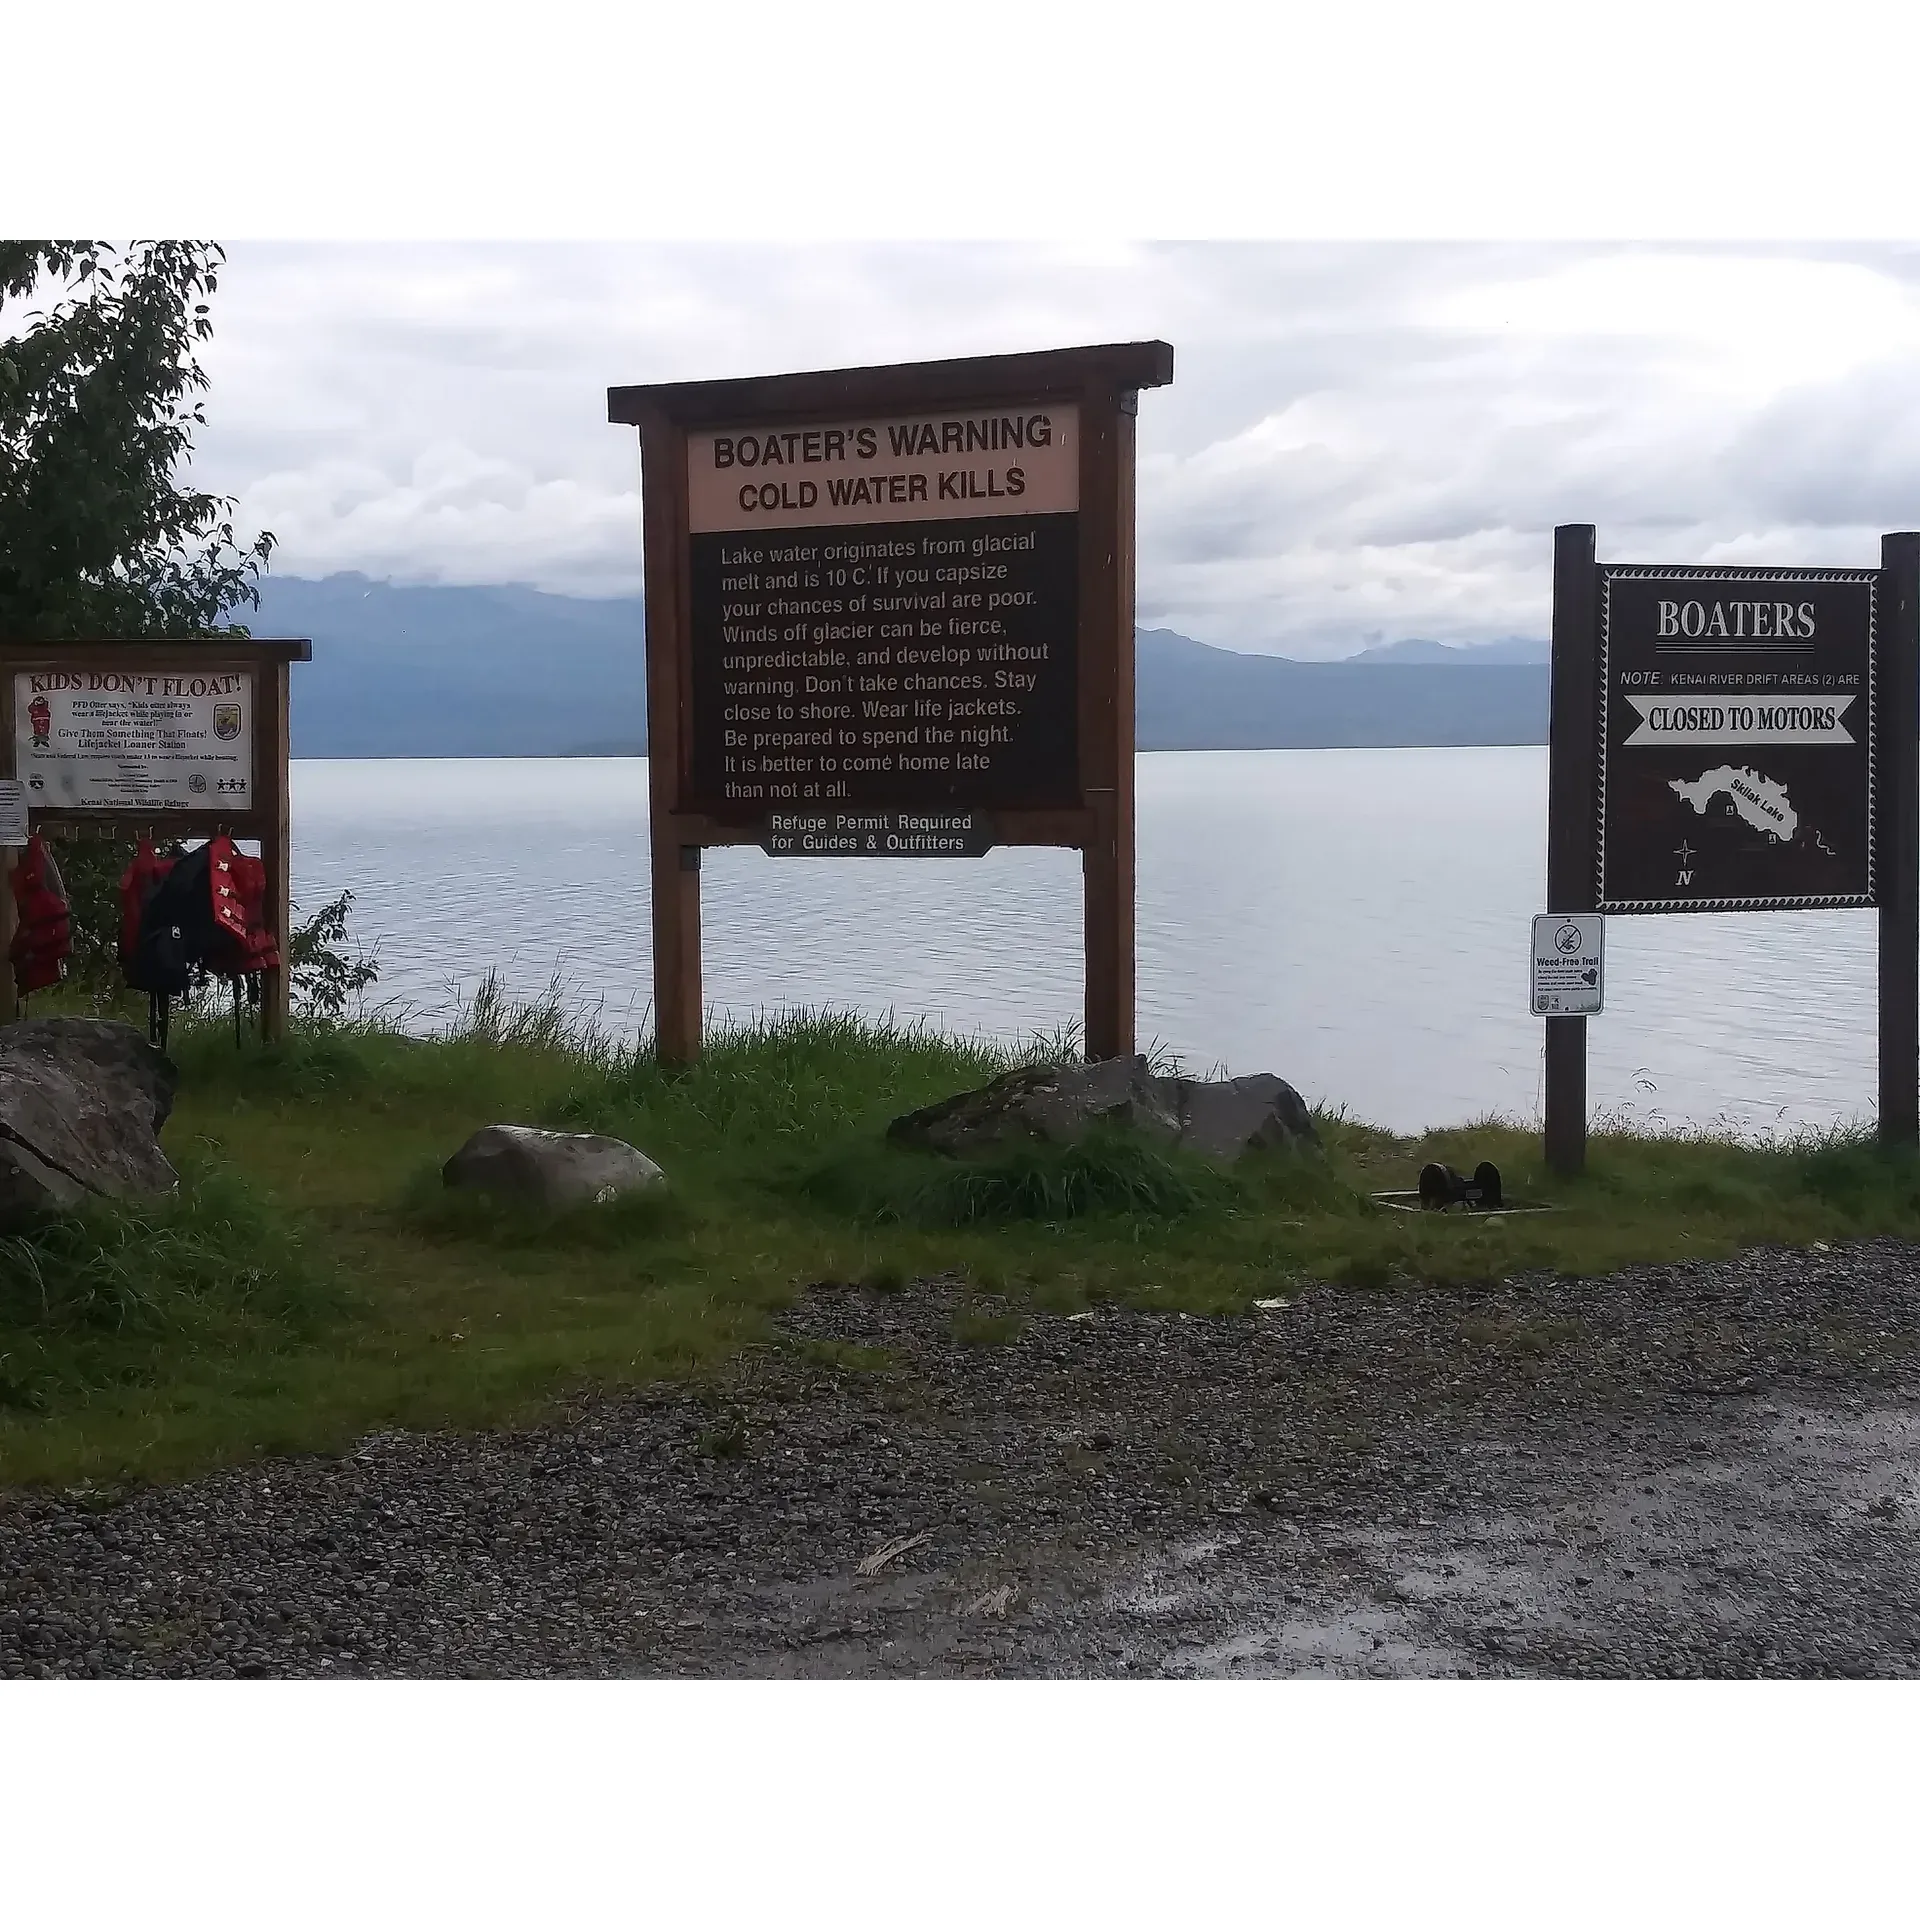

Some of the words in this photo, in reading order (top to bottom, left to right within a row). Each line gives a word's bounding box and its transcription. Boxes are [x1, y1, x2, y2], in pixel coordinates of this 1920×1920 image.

[714, 428, 876, 468] BOATER'S
[888, 415, 1051, 456] WARNING
[739, 480, 818, 512] COLD
[827, 474, 928, 505] WATER
[938, 468, 1025, 499] KILLS
[721, 546, 763, 565] Lake
[769, 546, 818, 562] water
[824, 540, 916, 562] originates
[922, 537, 965, 555] from
[972, 532, 1035, 557] glacial
[722, 573, 760, 591] melt
[765, 571, 798, 589] and
[804, 568, 819, 588] is
[827, 568, 847, 586] 10
[877, 566, 889, 584] If
[895, 567, 929, 588] you
[936, 562, 1008, 582] capsize
[723, 602, 761, 621] your
[768, 596, 842, 616] chances
[849, 594, 866, 612] of
[873, 593, 945, 611] survival
[952, 592, 982, 608] are
[988, 590, 1037, 611] poor.
[723, 624, 778, 643] Winds
[784, 622, 808, 640] off
[813, 620, 874, 644] glacier
[880, 621, 913, 638] can
[920, 618, 942, 636] be
[949, 617, 1007, 637] fierce,
[1657, 600, 1815, 638] BOATERS
[723, 648, 850, 672] unpredictable,
[857, 647, 890, 666] and
[896, 645, 970, 667] develop
[977, 643, 1049, 662] without
[30, 672, 82, 693] KIDS
[88, 674, 158, 696] DON'T
[162, 674, 242, 697] FLOAT!
[724, 678, 799, 698] warning.
[806, 674, 854, 694] Don't
[860, 674, 898, 692] take
[904, 672, 988, 691] chances.
[995, 669, 1037, 691] Stay
[1671, 674, 1706, 685] KENAI
[1710, 674, 1743, 685] RIVER
[1747, 674, 1778, 685] DRIFT
[1781, 674, 1819, 685] AREAS
[1822, 674, 1835, 686] (2)
[1838, 674, 1860, 685] ARE
[167, 701, 190, 710] always
[724, 702, 771, 721] close
[776, 704, 794, 720] to
[800, 700, 855, 719] shore.
[862, 700, 907, 718] Wear
[914, 699, 942, 717] life
[948, 698, 1022, 721] jackets.
[1649, 707, 1724, 731] CLOSED
[1728, 707, 1753, 731] TO
[1757, 707, 1835, 731] MOTORS
[58, 729, 78, 738] Give
[80, 729, 104, 738] Them
[106, 729, 154, 739] Something
[157, 729, 176, 738] That
[178, 729, 207, 738] Floats!
[78, 740, 121, 750] Lifejacket
[124, 740, 156, 748] Loaner
[158, 740, 186, 748] Station
[724, 729, 748, 747] Be
[754, 728, 833, 750] prepared
[839, 728, 857, 744] to
[862, 726, 918, 748] spend
[924, 726, 954, 743] the
[960, 724, 1014, 747] night.
[725, 756, 736, 772] It
[742, 755, 756, 772] is
[763, 754, 814, 772] better
[819, 755, 837, 771] to
[842, 756, 892, 771] come
[899, 754, 950, 771] home
[957, 752, 990, 770] late
[725, 781, 763, 798] than
[770, 782, 798, 797] not
[803, 782, 820, 797] at
[826, 780, 851, 797] all.
[1730, 779, 1761, 806] Skilak
[1760, 800, 1784, 822] Lake
[772, 814, 826, 832] Refuge
[836, 814, 889, 830] Permit
[898, 814, 972, 832] Required
[772, 835, 794, 850] for
[803, 834, 857, 850] Guides
[866, 835, 877, 850] &
[886, 834, 964, 850] Outfitters
[1675, 870, 1694, 885] N
[1537, 958, 1579, 966] Weed-Free
[1582, 957, 1598, 965] Trail
